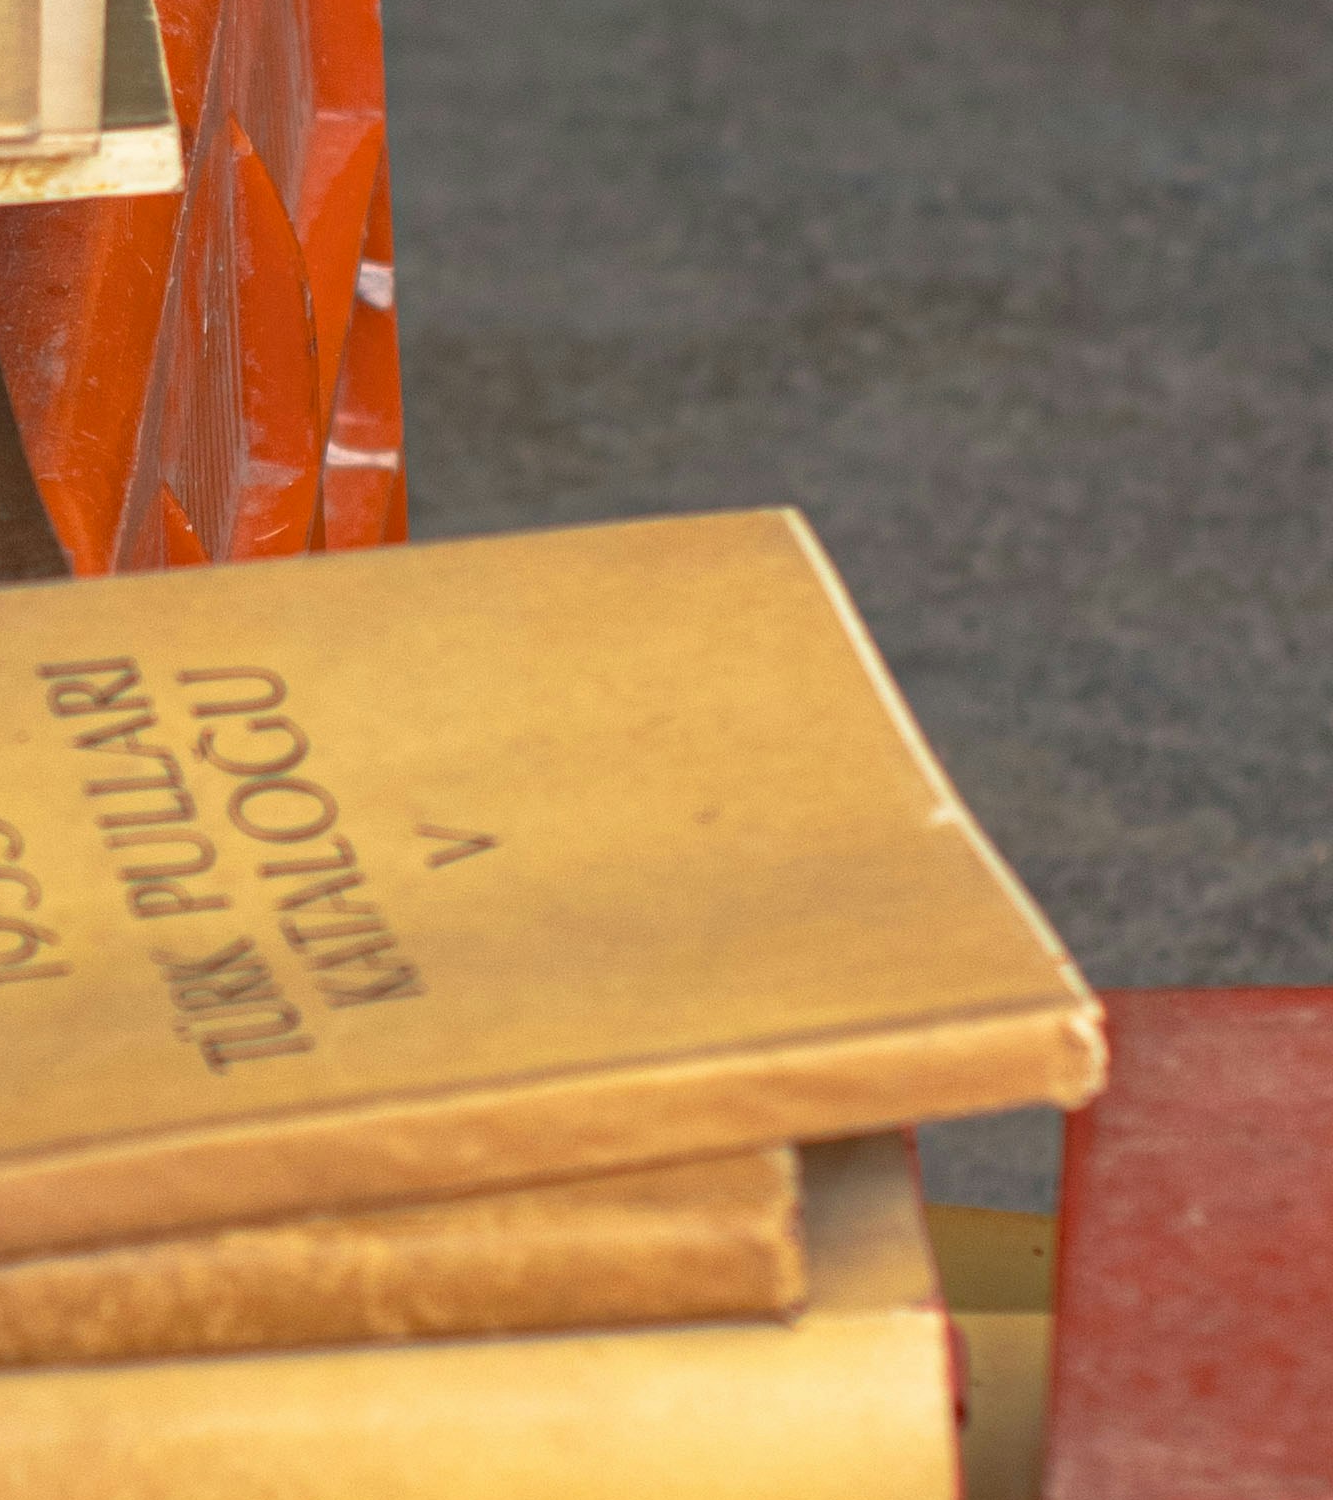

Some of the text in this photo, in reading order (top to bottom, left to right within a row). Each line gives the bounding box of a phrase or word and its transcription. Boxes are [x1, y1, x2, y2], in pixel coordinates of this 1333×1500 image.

[35, 655, 316, 1076] TÜRK PULLARI
[176, 665, 427, 1012] KATALOĞU
